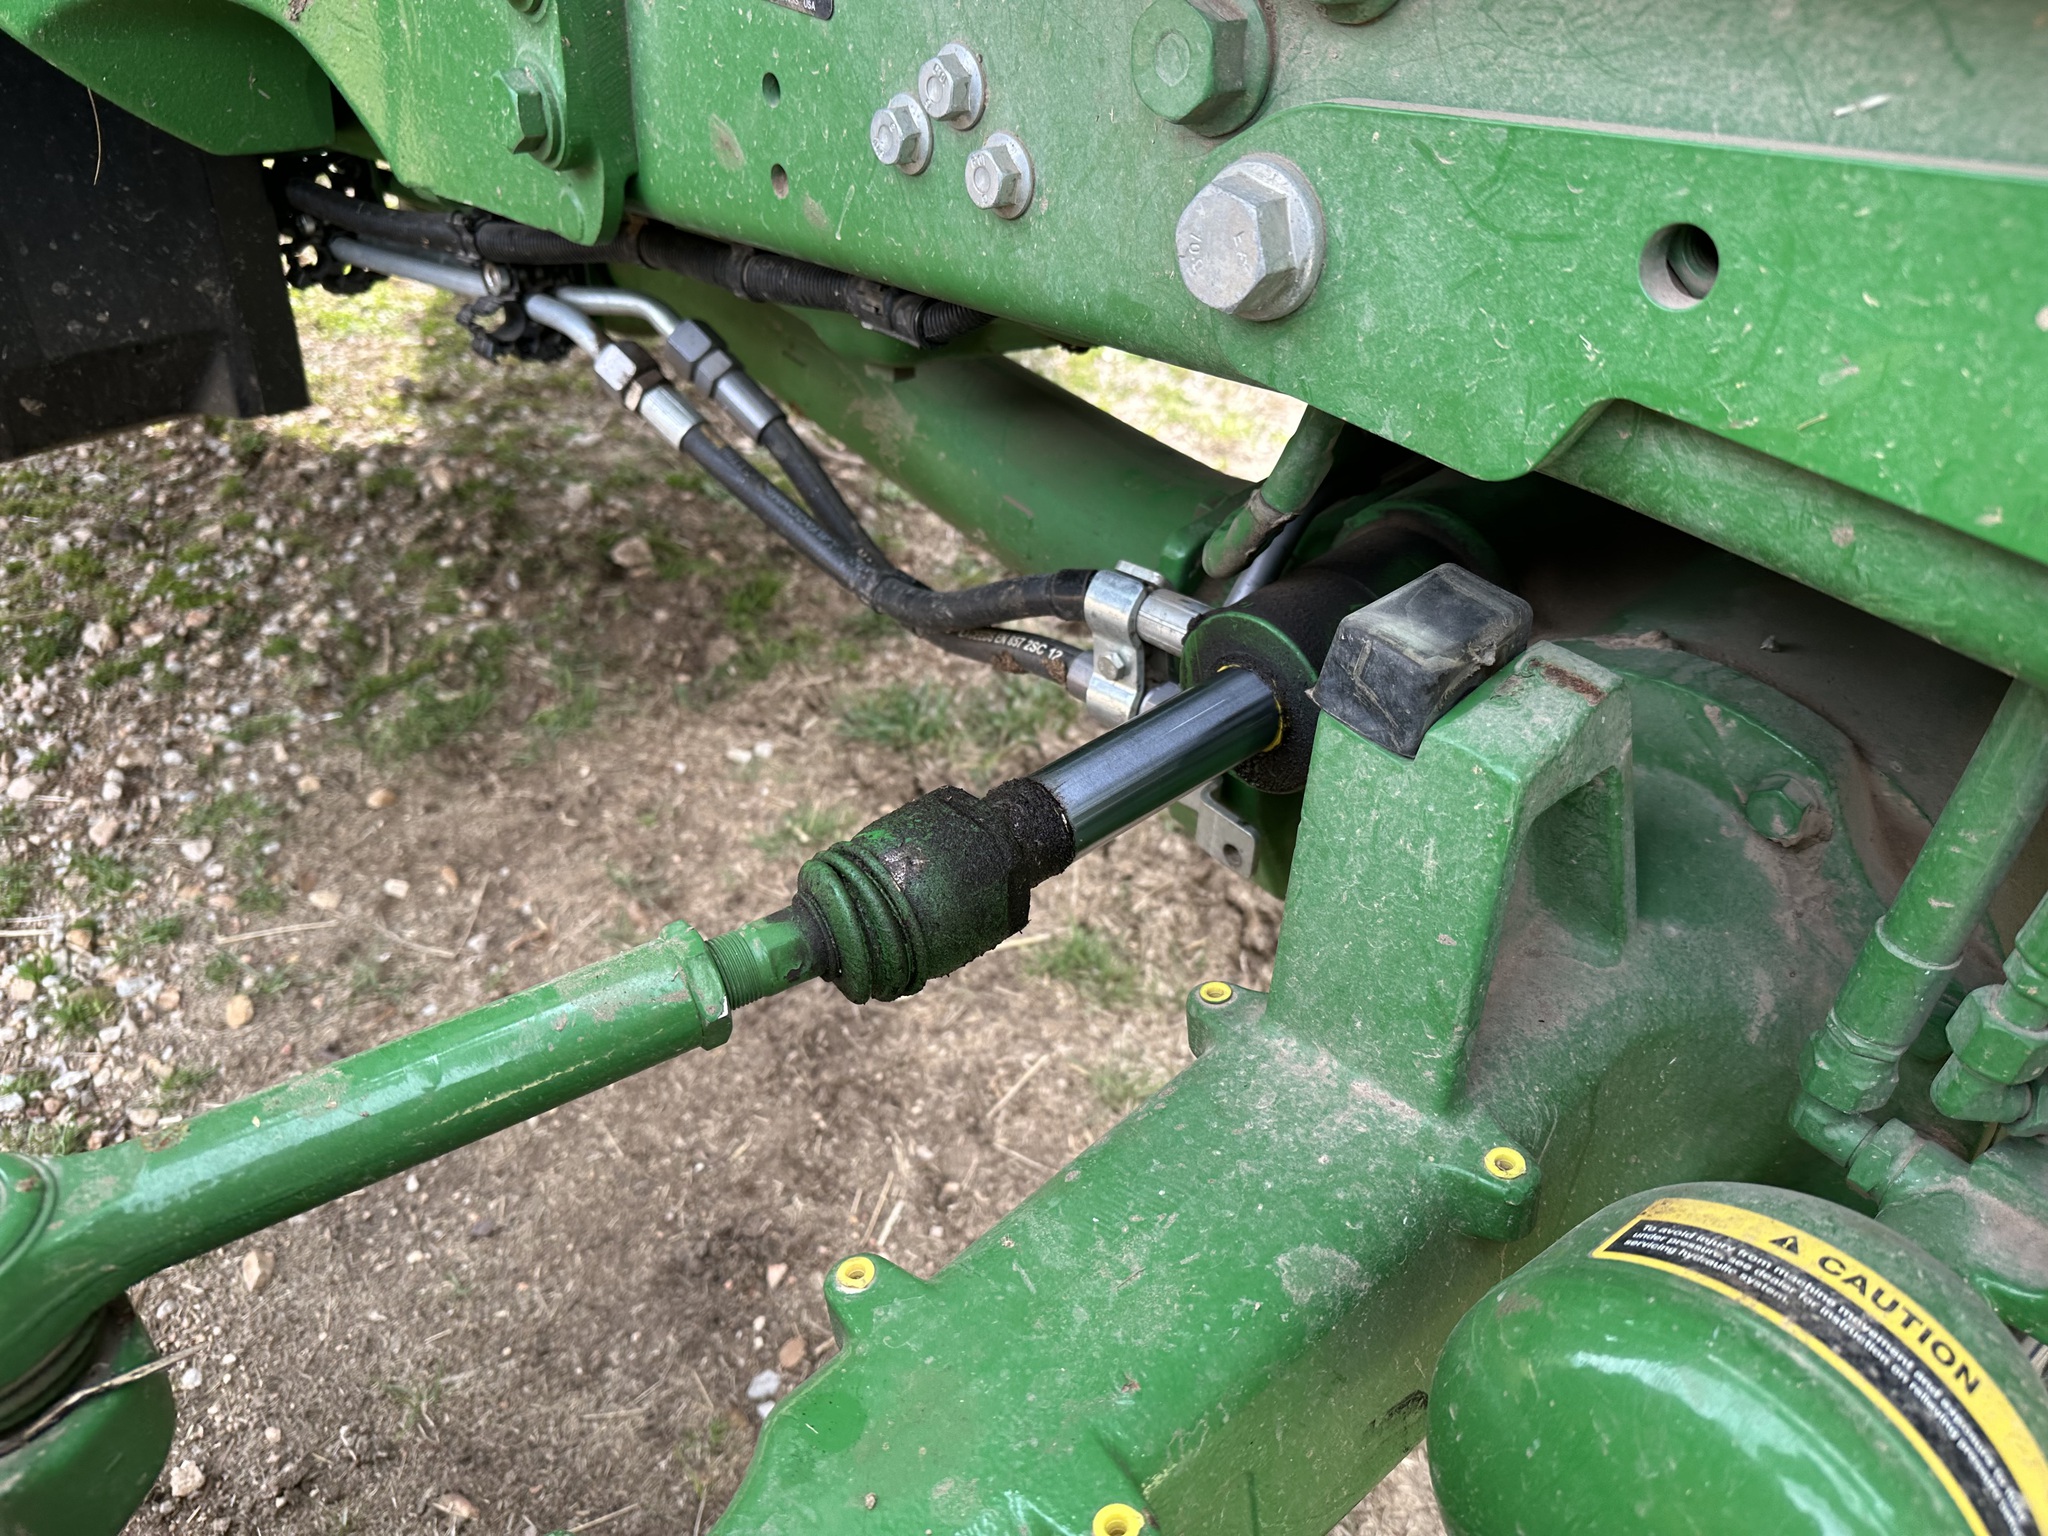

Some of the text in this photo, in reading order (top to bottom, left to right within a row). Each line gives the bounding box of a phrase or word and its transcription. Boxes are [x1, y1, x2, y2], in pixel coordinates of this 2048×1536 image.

[803, 0, 816, 11] USA
[1023, 639, 1047, 655] 2SC
[1624, 1239, 1677, 1255] servicing
[1678, 1248, 1738, 1274] hydraulic
[1632, 1232, 1667, 1243] under
[1728, 1256, 1752, 1271] see
[1754, 1268, 1796, 1293] dealer
[1798, 1291, 1820, 1308] for
[1820, 1306, 1890, 1366] instruction
[1890, 1363, 1909, 1384] on
[1908, 1381, 1960, 1440] relieving
[1643, 1224, 1657, 1232] To
[1659, 1227, 1697, 1240] avoid
[1696, 1233, 1736, 1252] injury
[1737, 1248, 1772, 1269] from
[1774, 1266, 1836, 1307] machine
[1838, 1305, 1915, 1371] movement
[1913, 1370, 1943, 1399] and
[1818, 1256, 1980, 1394] CAUTION
